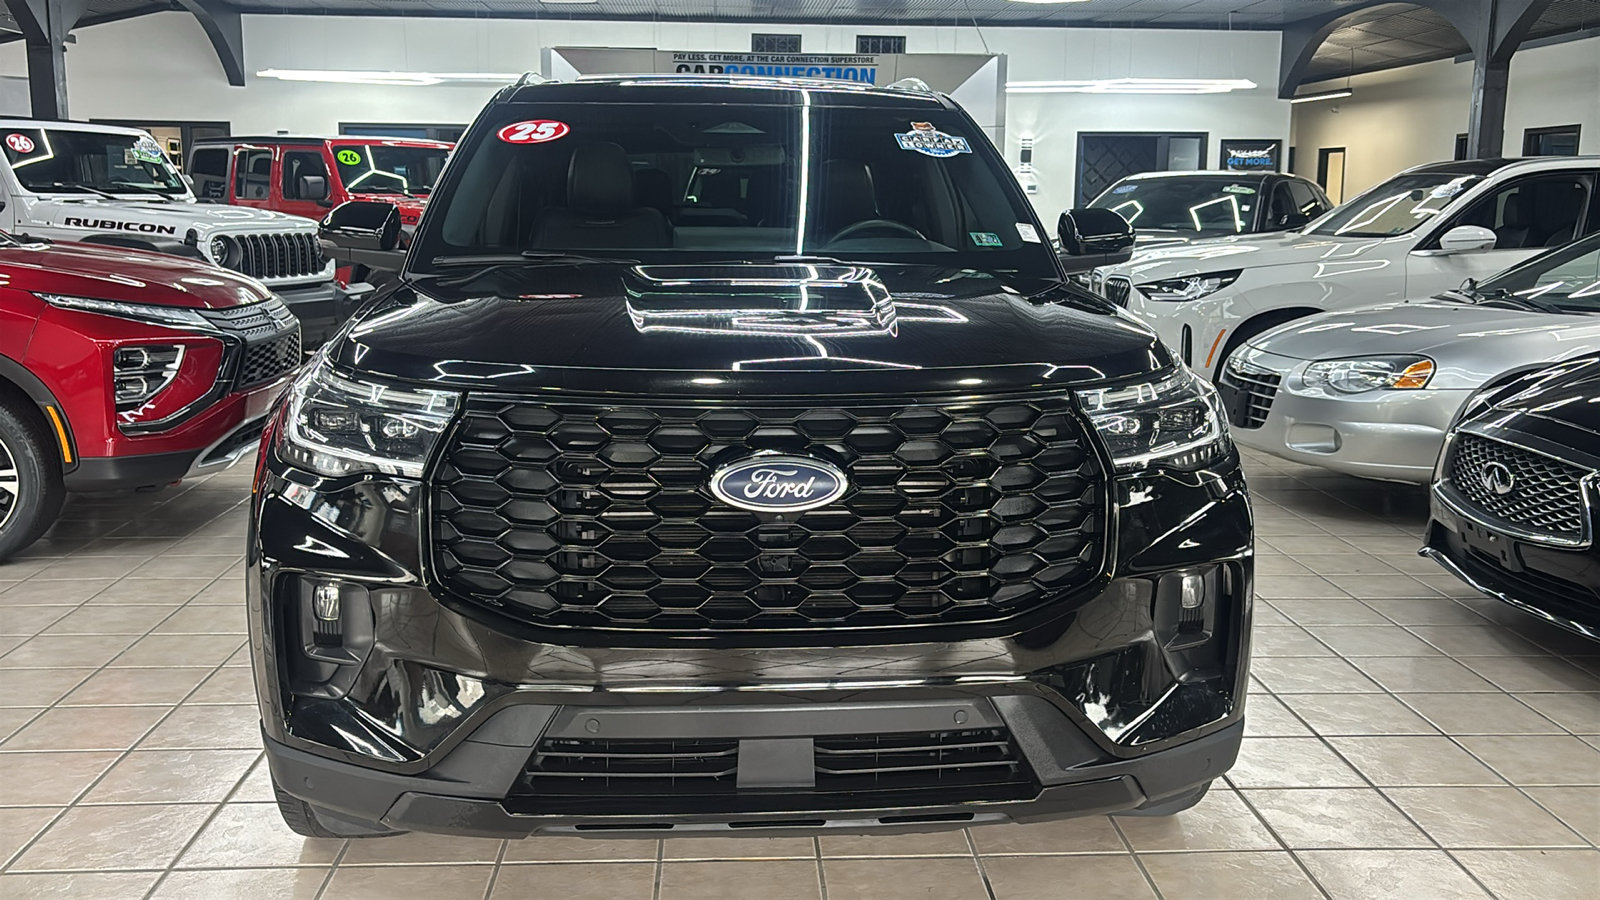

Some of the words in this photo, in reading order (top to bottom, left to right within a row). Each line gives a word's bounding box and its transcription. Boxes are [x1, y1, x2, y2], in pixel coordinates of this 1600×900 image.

[673, 53, 687, 61] PAY
[723, 54, 746, 62] MORE.
[756, 55, 769, 63] THE
[508, 122, 560, 141] 25
[10, 135, 31, 151] 26
[915, 142, 965, 150] OWNER
[342, 153, 357, 162] 26
[1226, 157, 1244, 166] GET
[1245, 157, 1274, 166] MORE.
[64, 217, 176, 235] RUBICON
[743, 468, 816, 499] Ford
